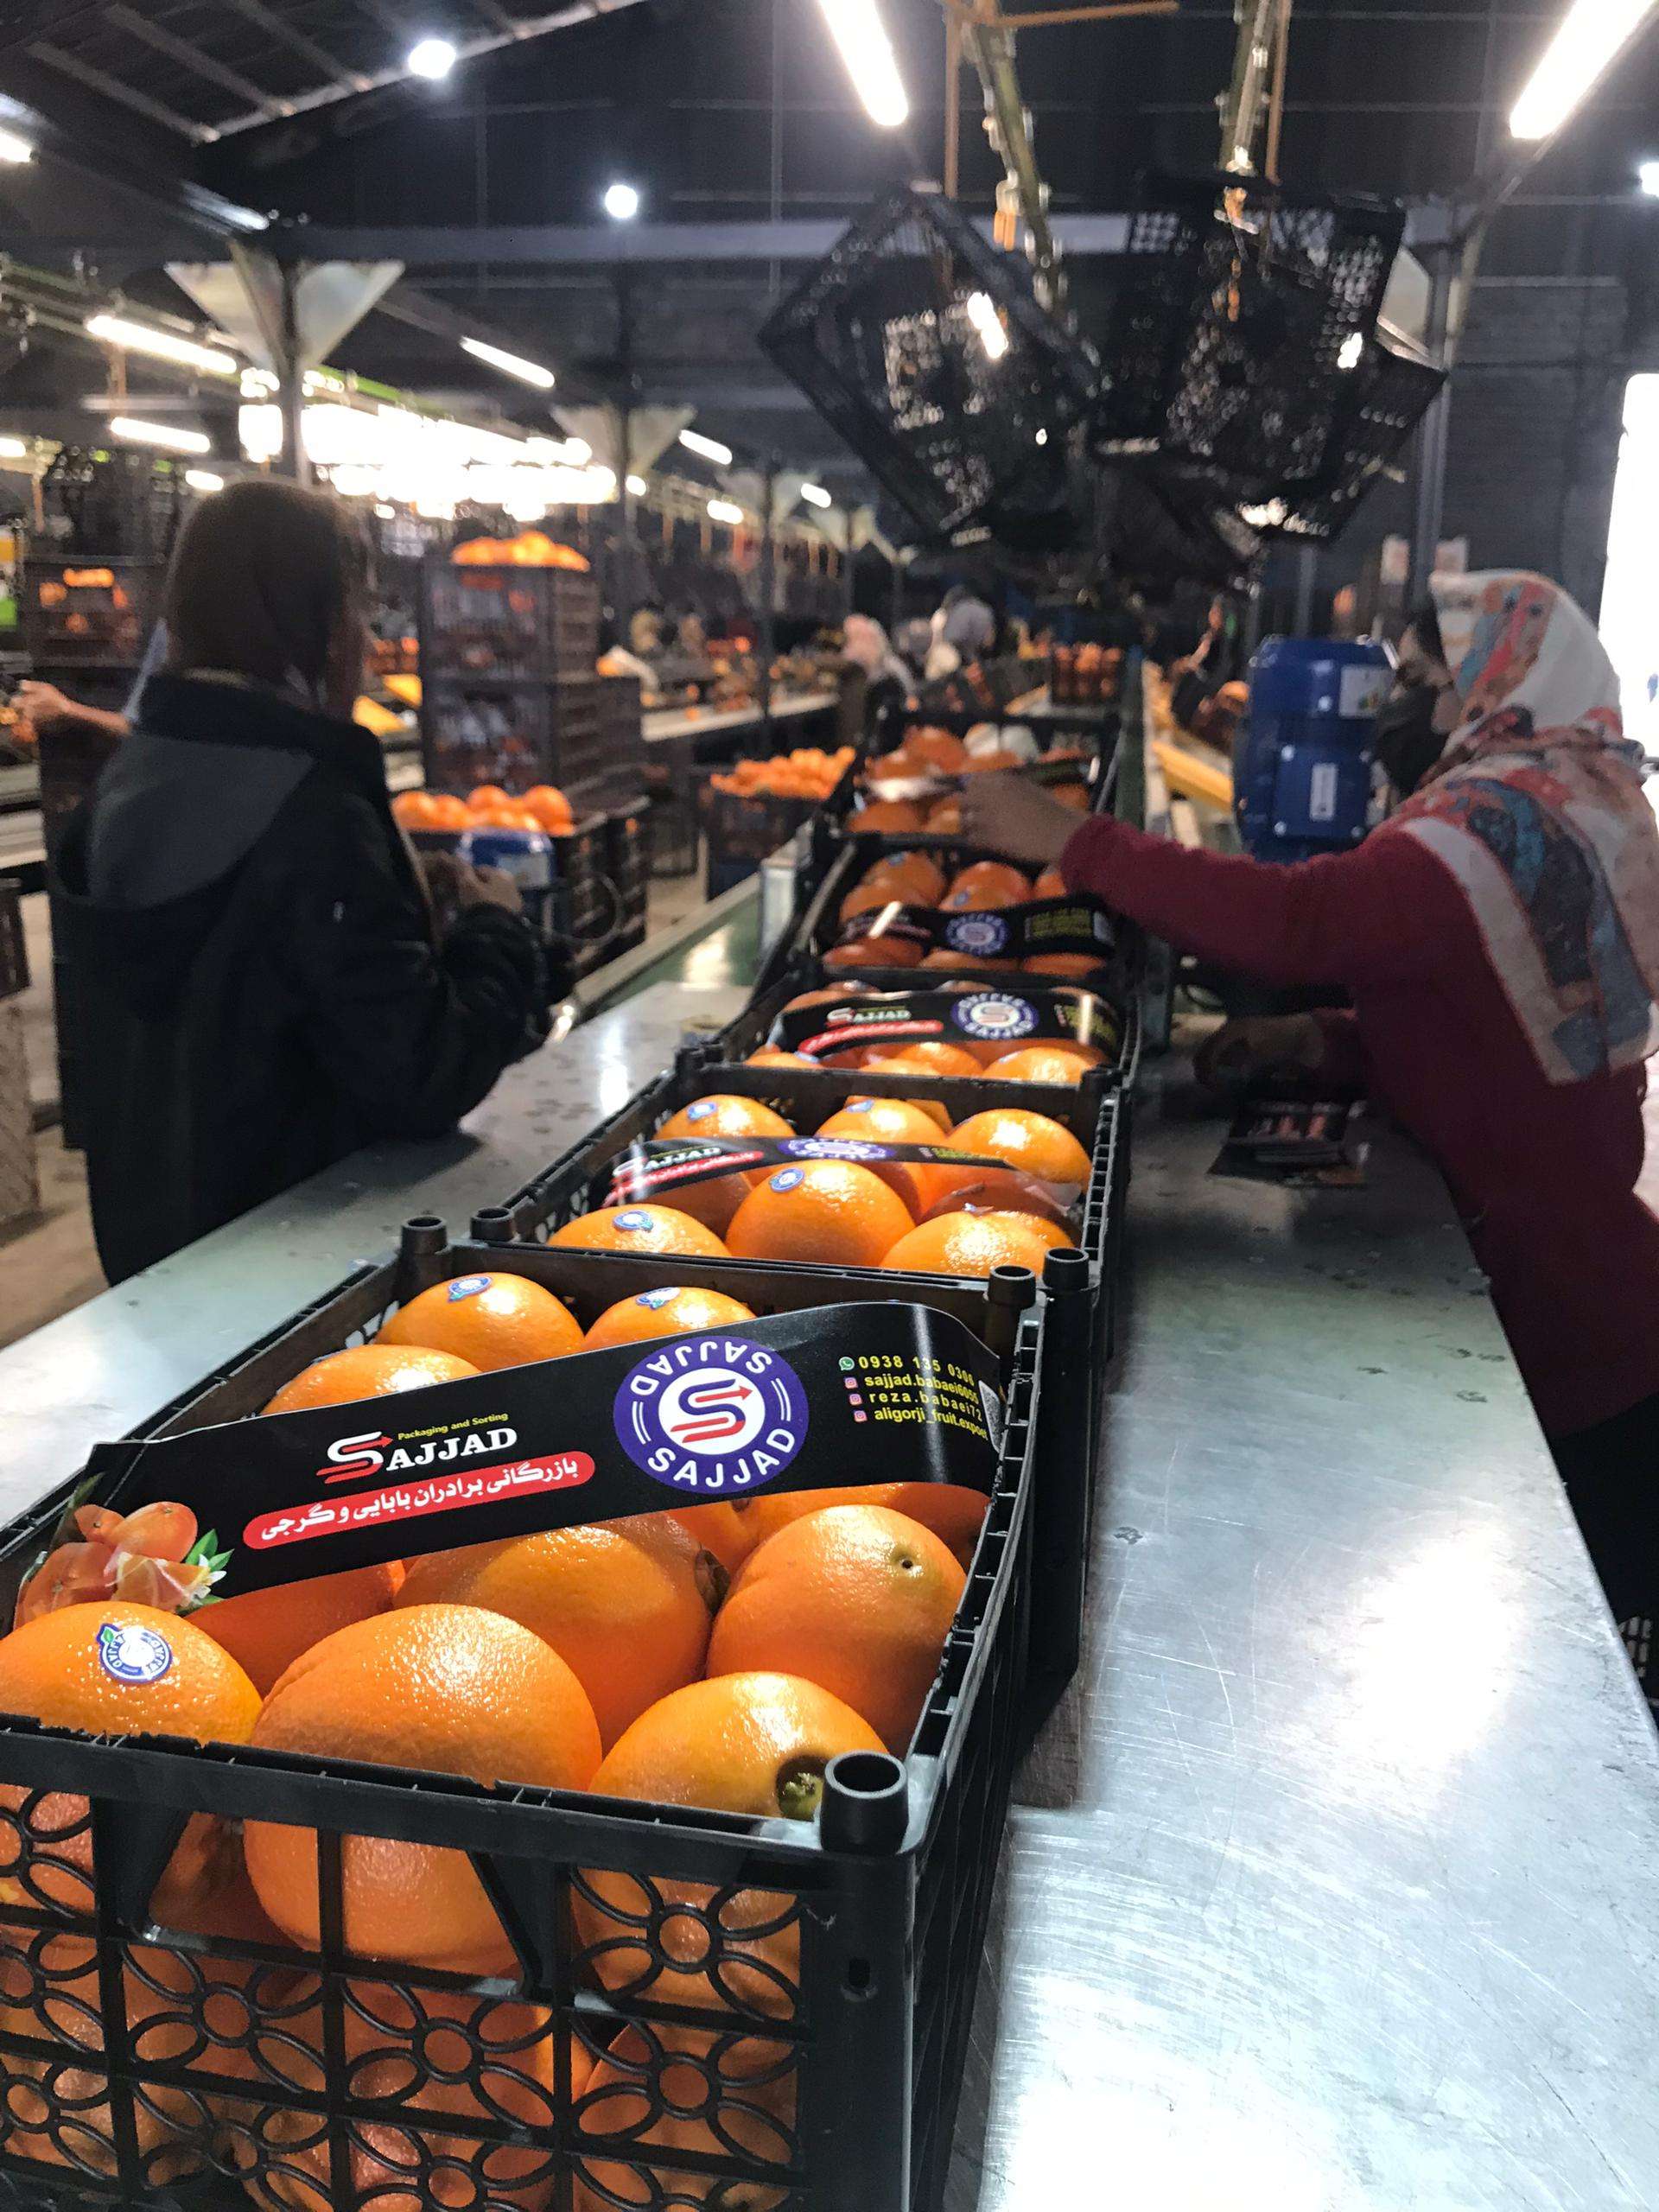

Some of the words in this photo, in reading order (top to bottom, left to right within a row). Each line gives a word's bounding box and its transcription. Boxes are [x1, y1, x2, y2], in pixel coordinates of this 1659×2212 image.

[630, 1340, 772, 1395] SAJJAD
[858, 1355, 904, 1370] 0938
[912, 1356, 941, 1372] 135
[869, 1391, 982, 1422] reza.babaei72
[398, 1425, 448, 1441] Packaging
[451, 1419, 470, 1430] and
[472, 1412, 509, 1426] Sorting
[316, 1427, 517, 1484] SAJJAD
[647, 1428, 795, 1488] SAJJAD
[486, 1457, 579, 1494] بازرگانی
[353, 1491, 411, 1521] بابایی
[414, 1477, 484, 1507] برادران
[261, 1503, 335, 1541] گرجی
[340, 1508, 349, 1523] و
